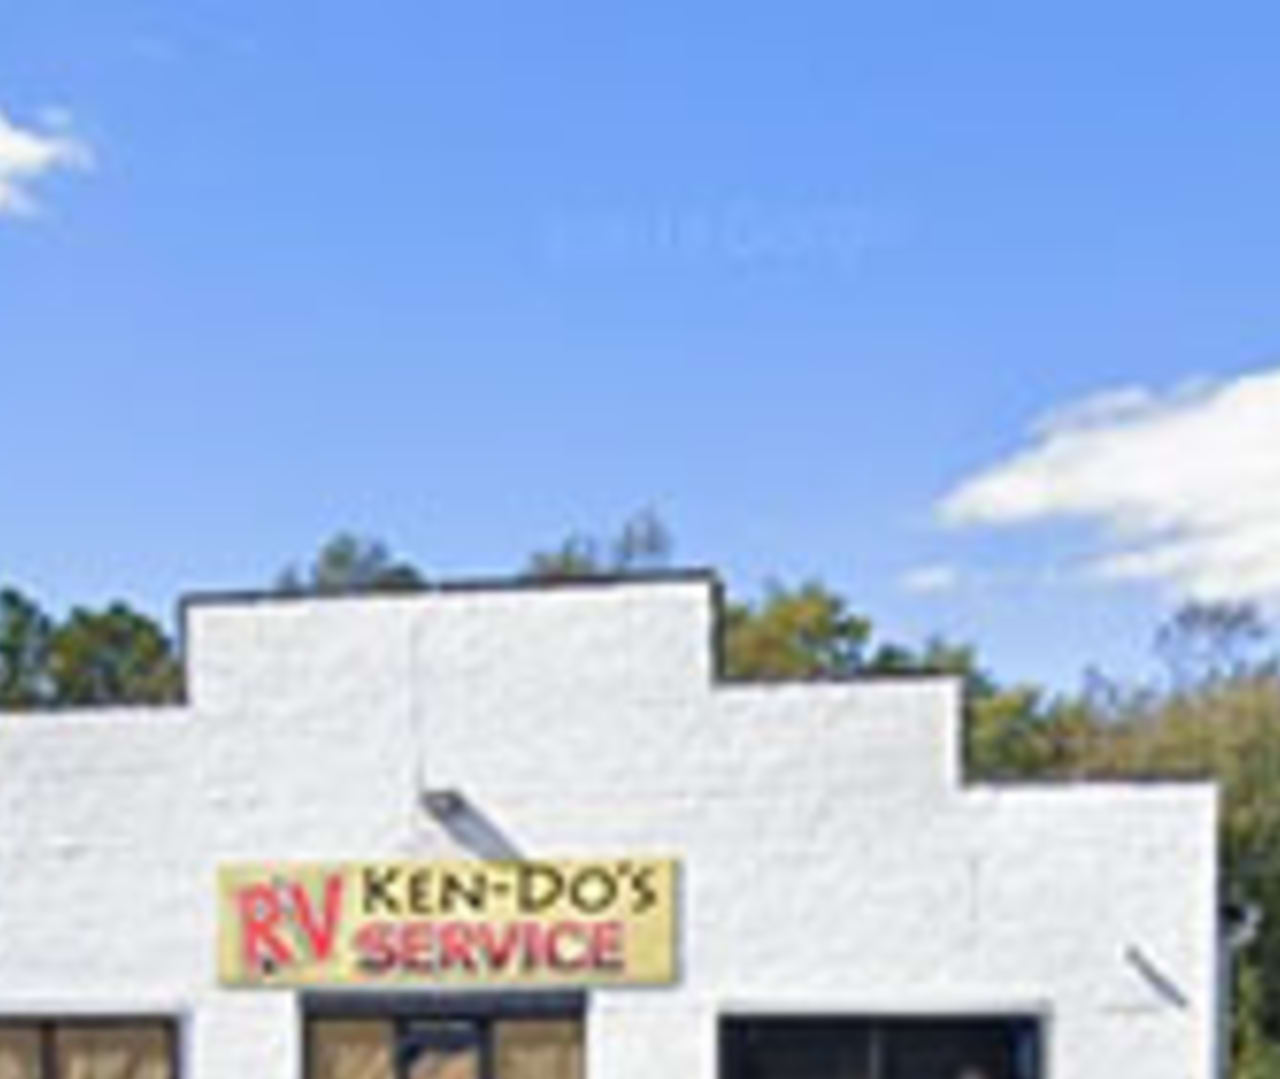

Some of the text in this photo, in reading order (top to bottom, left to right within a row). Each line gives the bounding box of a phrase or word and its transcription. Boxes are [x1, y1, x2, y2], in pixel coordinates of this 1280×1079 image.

[360, 863, 658, 913] KEN-DO'S
[235, 874, 345, 974] RV
[355, 921, 625, 974] SERVICE
